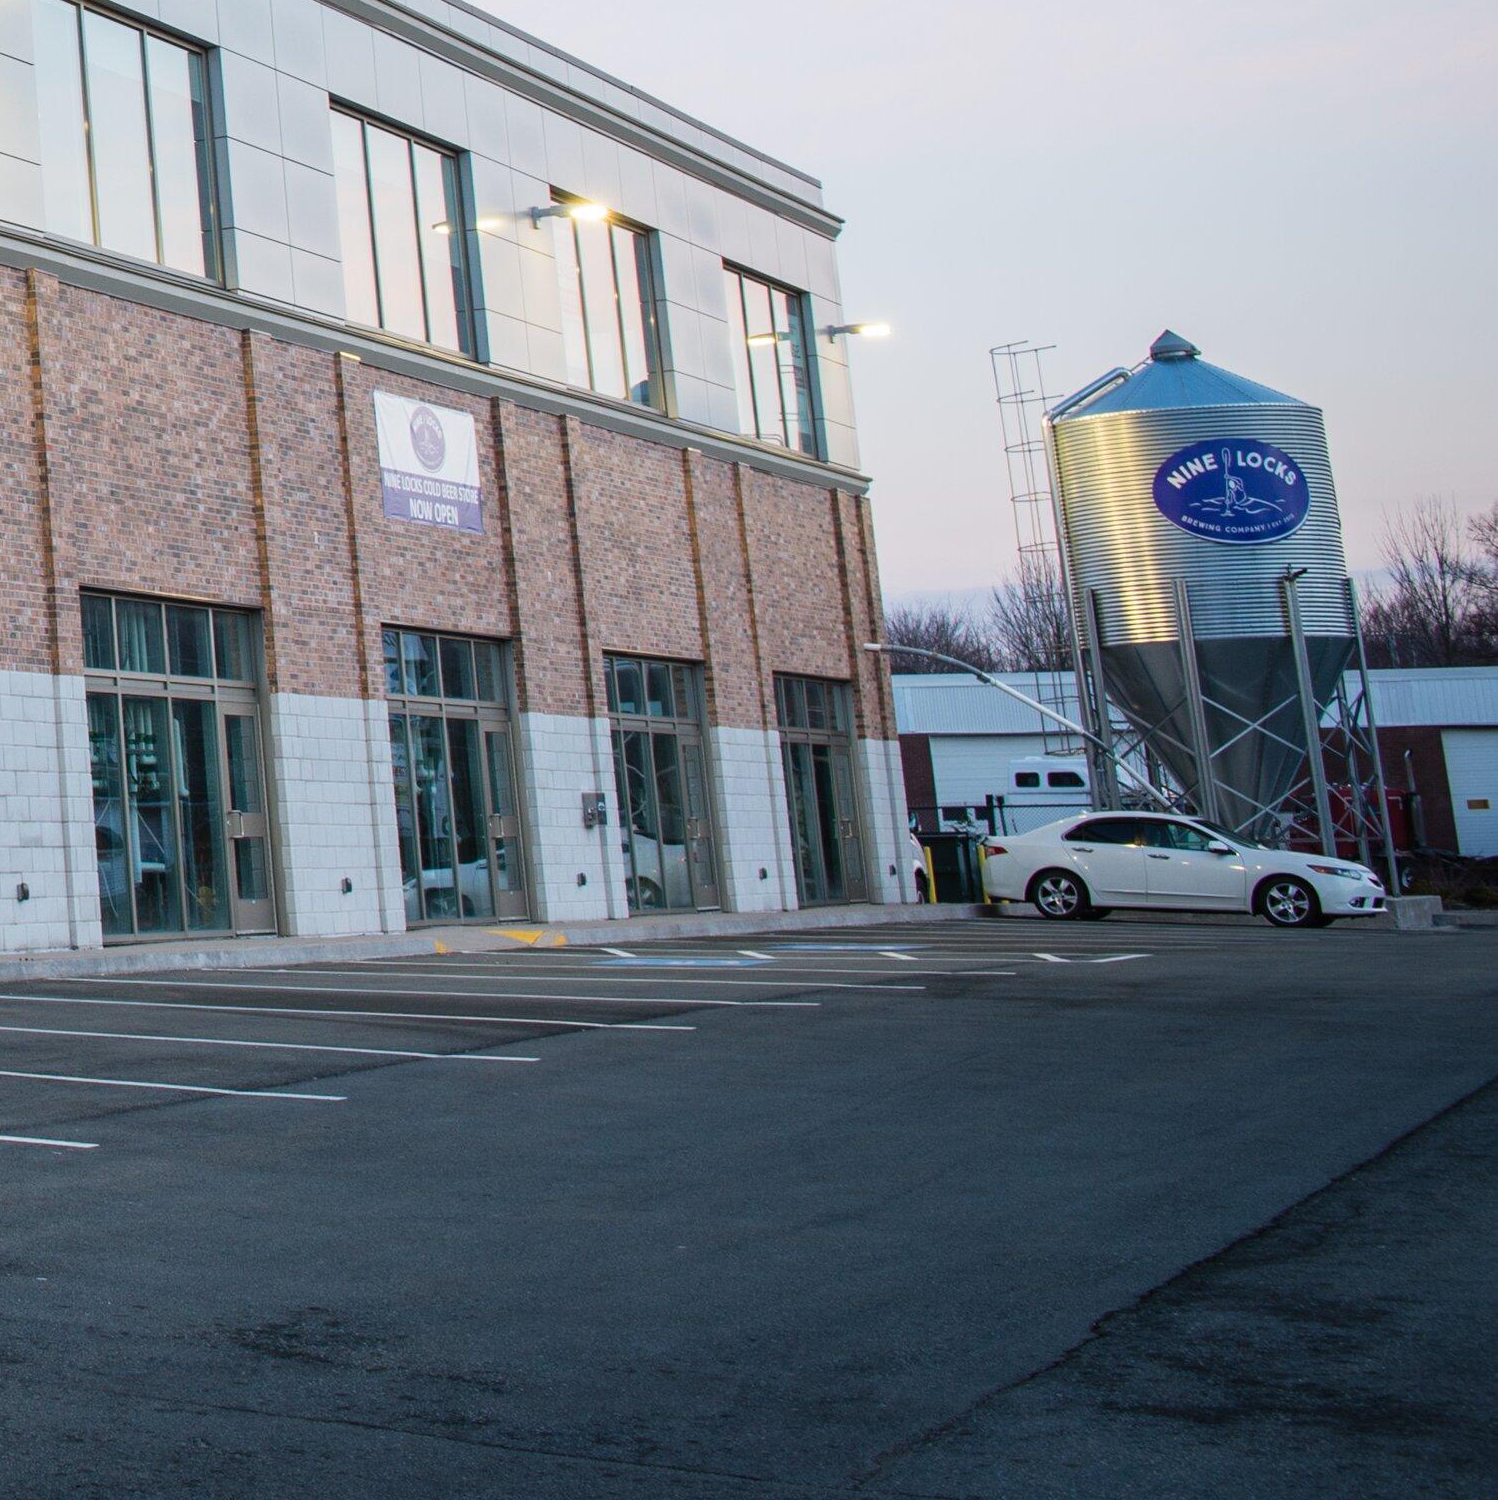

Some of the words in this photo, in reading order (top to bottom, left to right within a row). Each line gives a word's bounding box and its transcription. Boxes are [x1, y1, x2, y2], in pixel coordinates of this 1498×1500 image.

[1166, 453, 1218, 489] NINE
[1236, 450, 1296, 486] LOCKS
[384, 471, 401, 489] NINE
[402, 475, 423, 494] LOCKS
[423, 480, 441, 497] COLD
[442, 483, 458, 500] BEER
[458, 487, 479, 505] STORE
[409, 498, 433, 520] NOW
[434, 503, 459, 525] OPEN
[1181, 515, 1221, 532] BREWING
[1225, 525, 1266, 533] COMPANY
